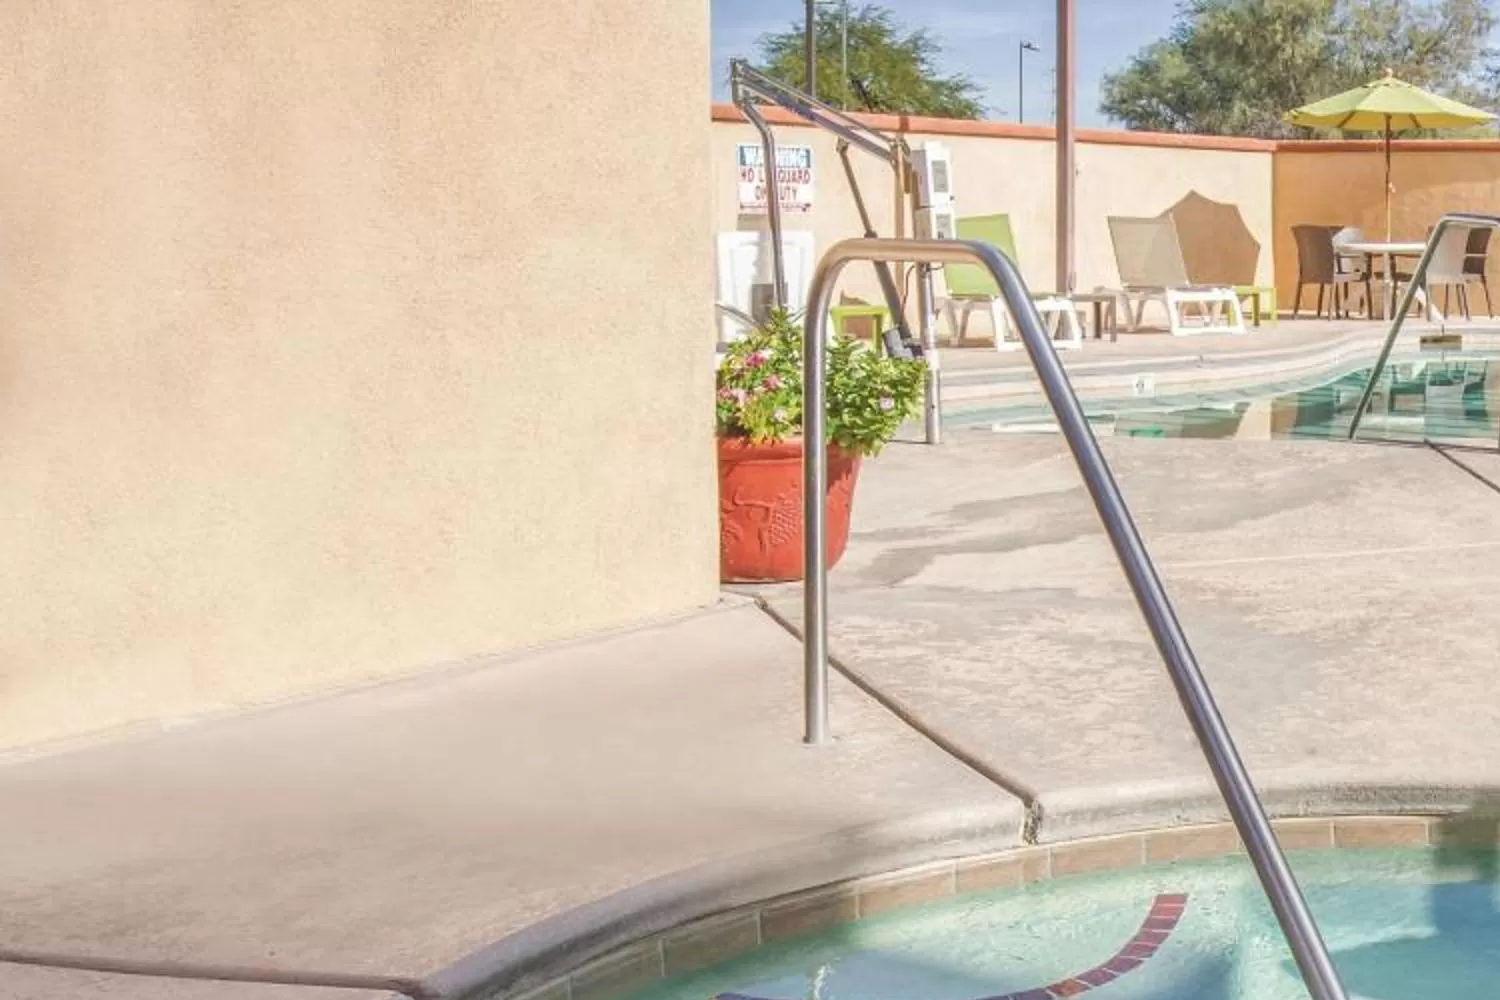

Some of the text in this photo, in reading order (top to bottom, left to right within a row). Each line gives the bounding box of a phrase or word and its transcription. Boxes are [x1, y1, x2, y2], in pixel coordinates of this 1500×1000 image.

[743, 146, 807, 167] WANING
[740, 168, 811, 184] NO LGUARD
[774, 185, 797, 200] UTY
